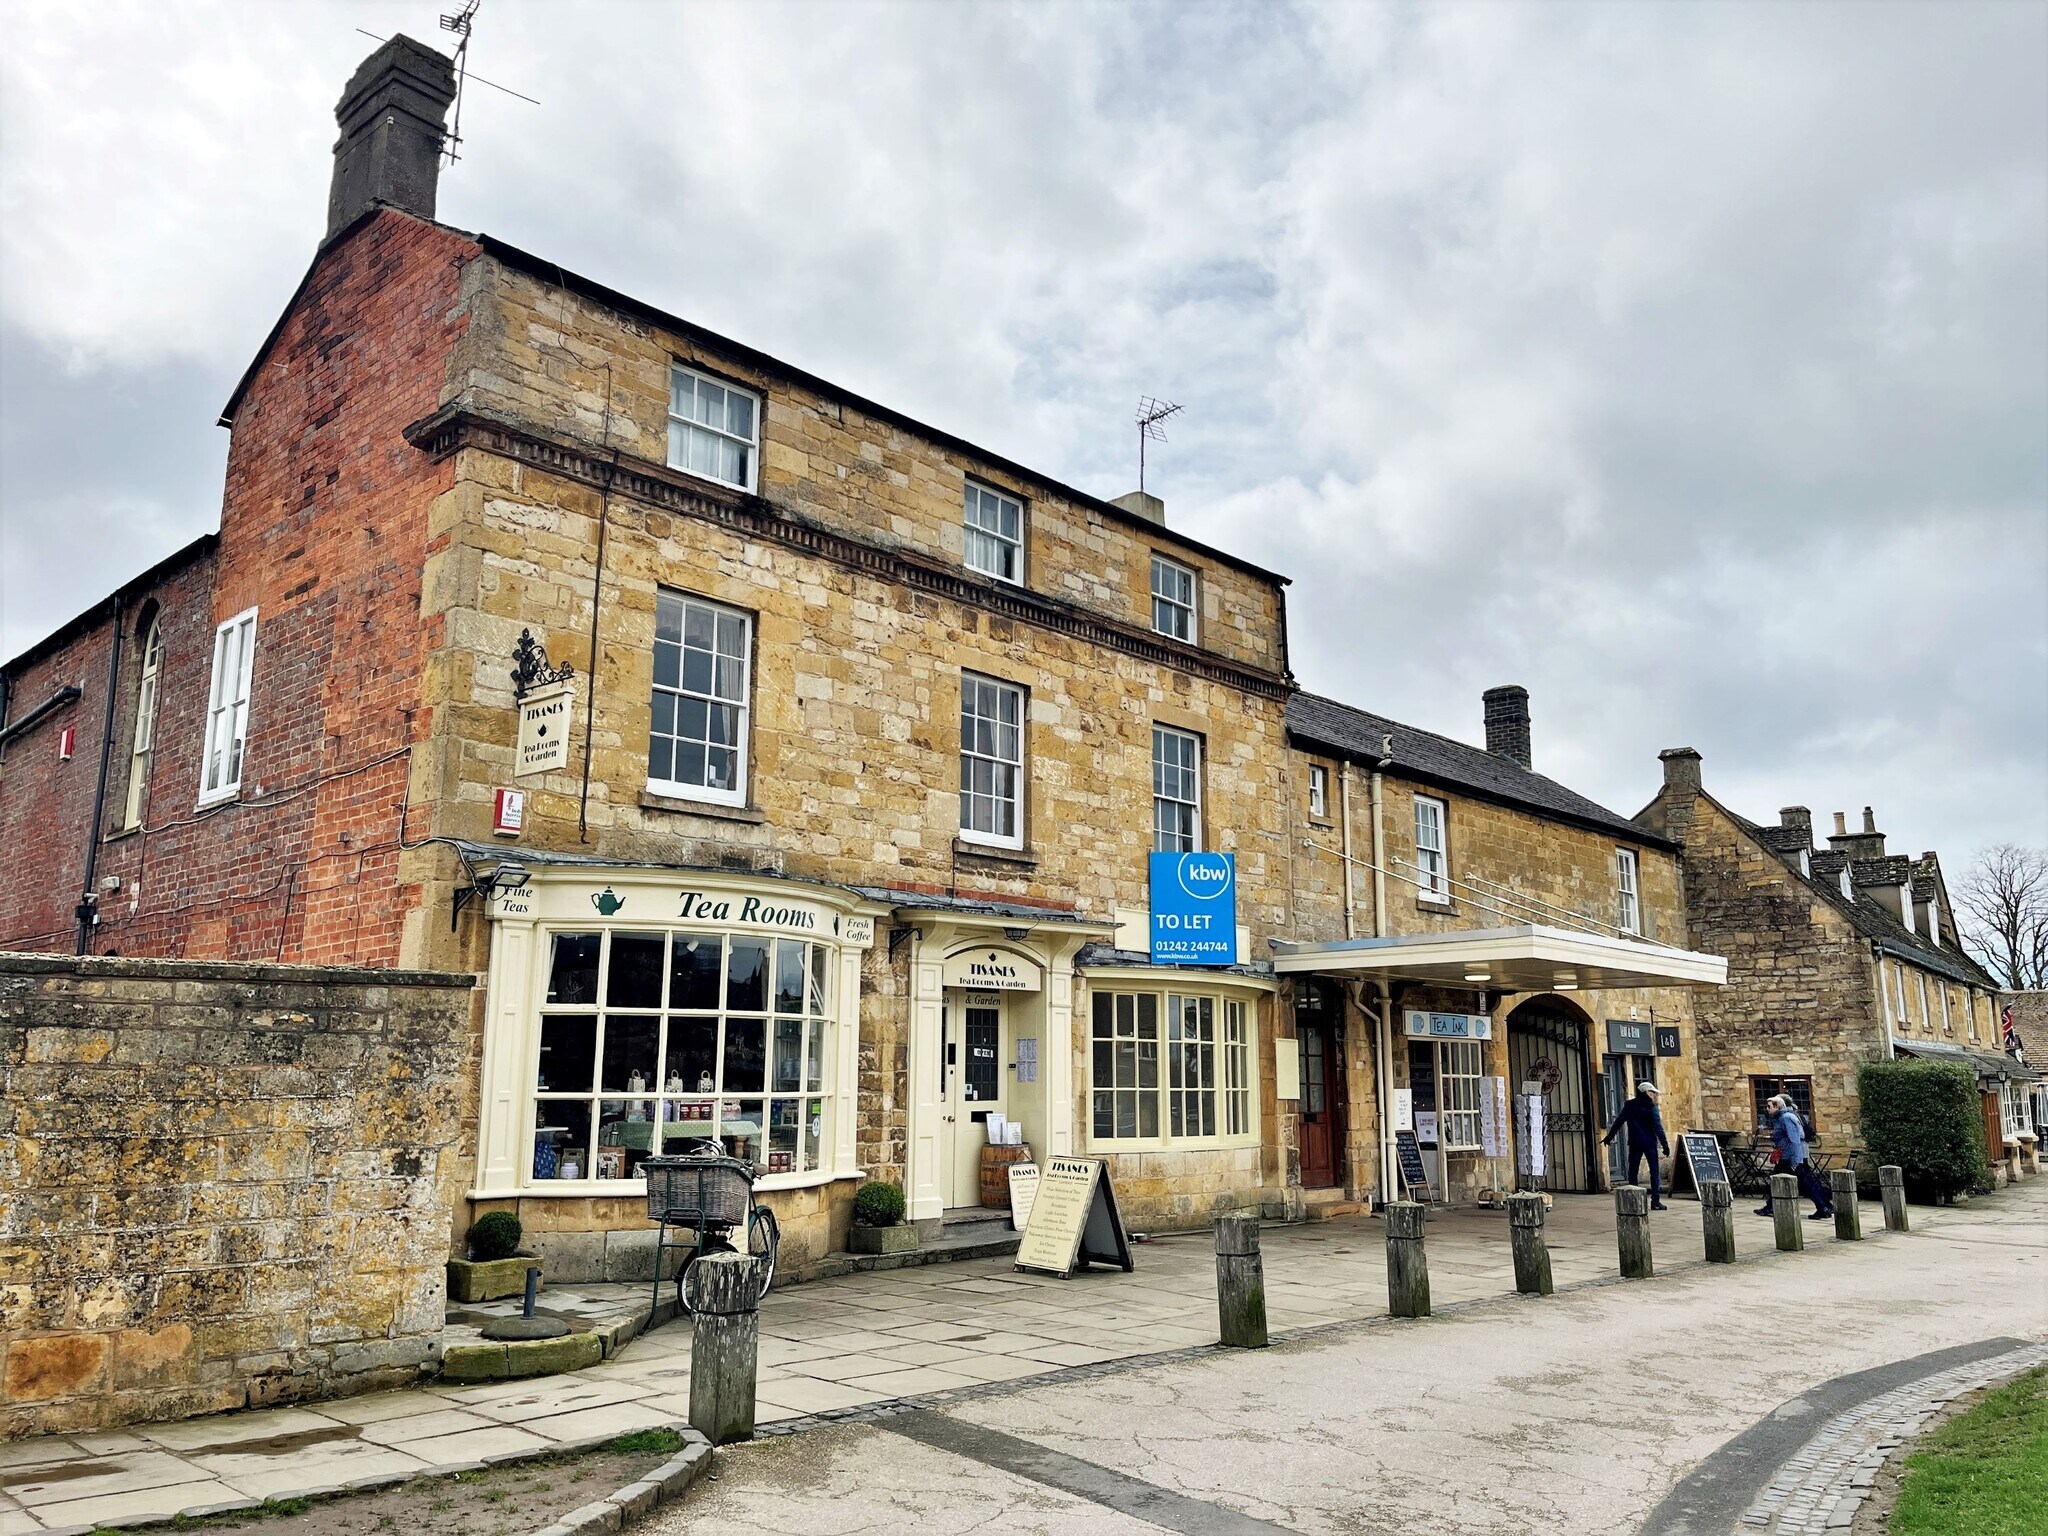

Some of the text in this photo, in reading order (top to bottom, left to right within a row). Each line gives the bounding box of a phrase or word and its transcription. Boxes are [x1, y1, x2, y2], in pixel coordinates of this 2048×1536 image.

[527, 702, 564, 720] TISANES
[524, 739, 560, 754] Tea Rooms
[531, 750, 557, 762] Garden
[1189, 864, 1226, 880] kbw
[503, 899, 529, 913] Teas
[678, 892, 815, 929] Tea Rooms
[847, 918, 869, 929] Fresh
[1156, 914, 1212, 929] TO LET
[846, 930, 870, 941] Coffee
[1156, 941, 1228, 952] 01242 244744
[970, 964, 1016, 977] TISANES
[965, 995, 1000, 1005] & Garden
[1432, 1018, 1447, 1032] TEA
[1052, 1162, 1088, 1174] TISANES
